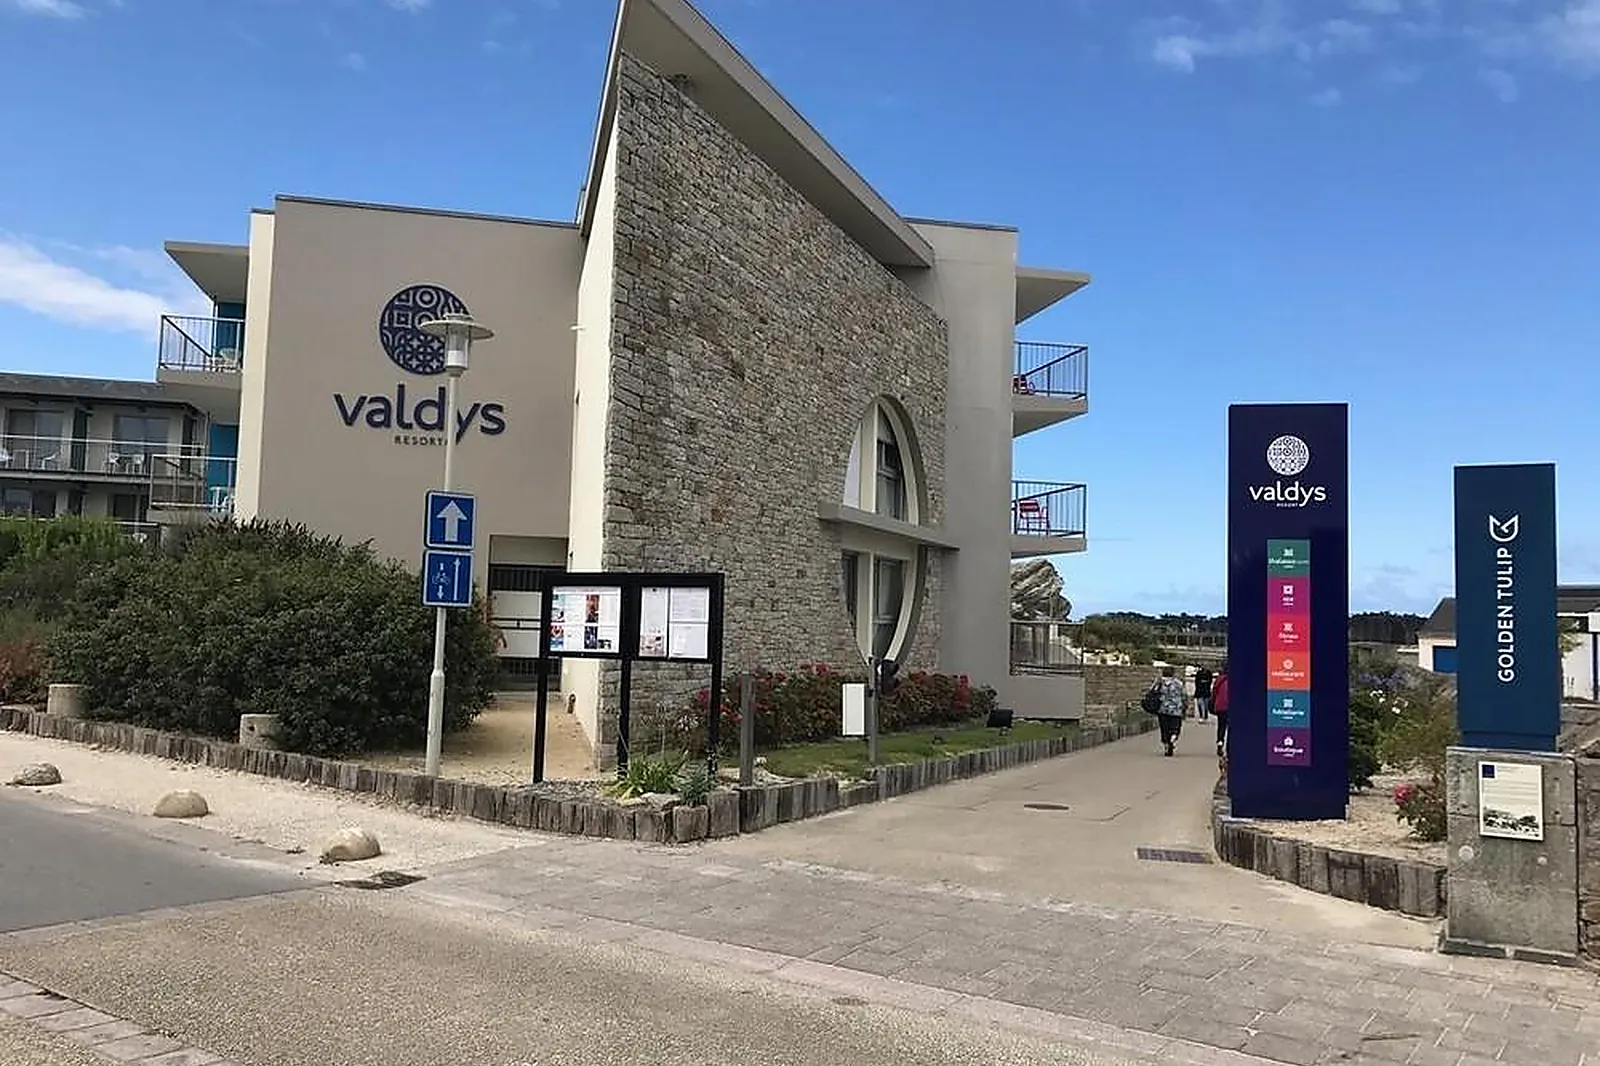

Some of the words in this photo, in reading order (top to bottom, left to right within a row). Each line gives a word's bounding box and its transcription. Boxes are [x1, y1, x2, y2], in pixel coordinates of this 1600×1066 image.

[333, 384, 506, 446] valdys
[1249, 481, 1327, 507] valdys
[1496, 547, 1514, 600] TULIP
[1497, 605, 1515, 683] GOLDEN
